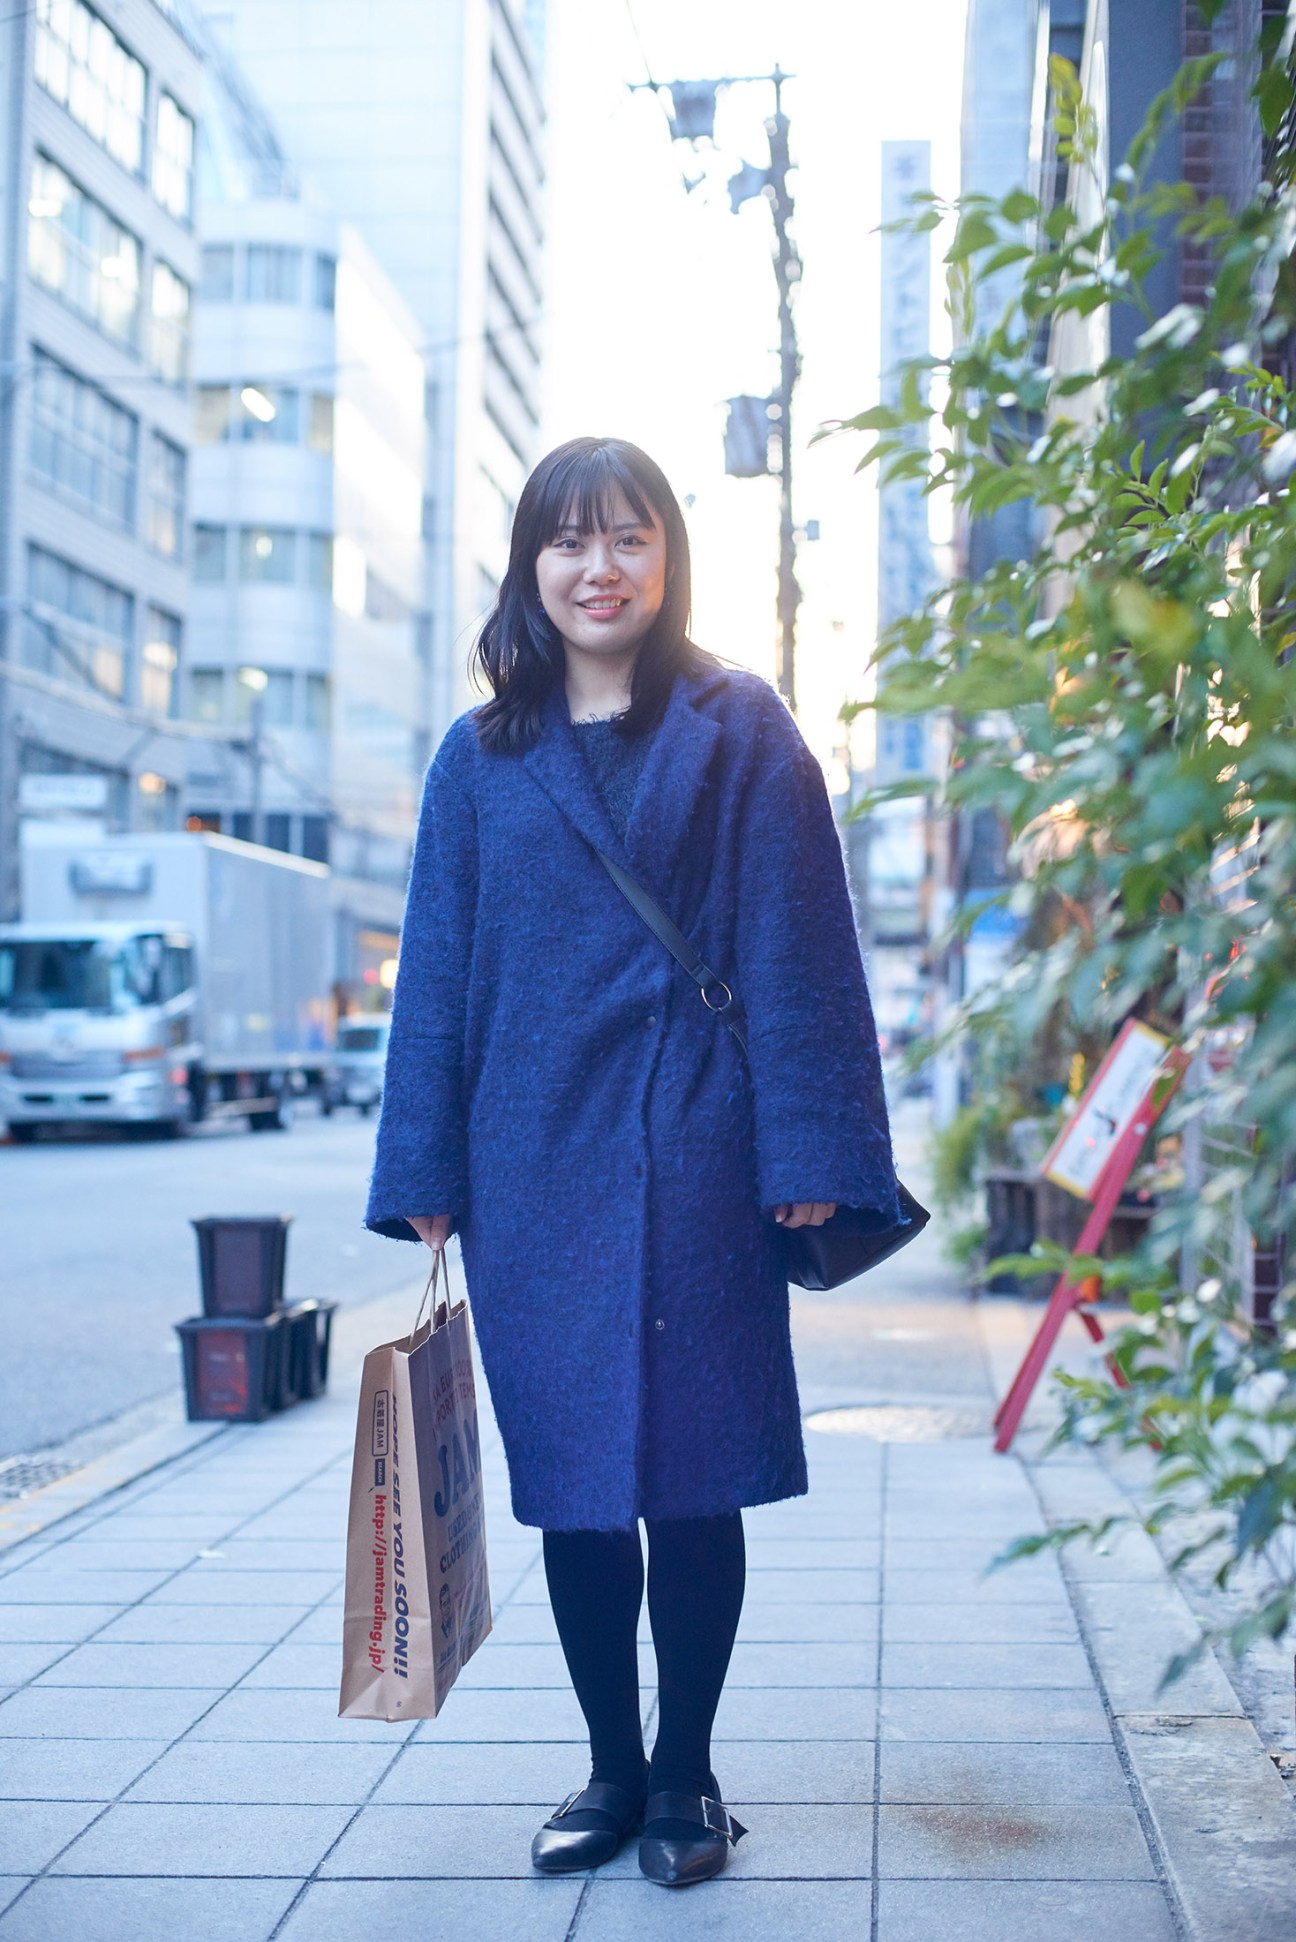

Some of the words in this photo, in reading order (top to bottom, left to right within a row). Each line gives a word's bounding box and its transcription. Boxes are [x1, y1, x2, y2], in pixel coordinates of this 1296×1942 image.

[376, 1398, 385, 1449] 古着屋JAM
[392, 1468, 402, 1518] SEE
[393, 1522, 406, 1578] YOU
[368, 1494, 388, 1673] http://jamtrading.jp/
[394, 1580, 410, 1679] SOON!!
